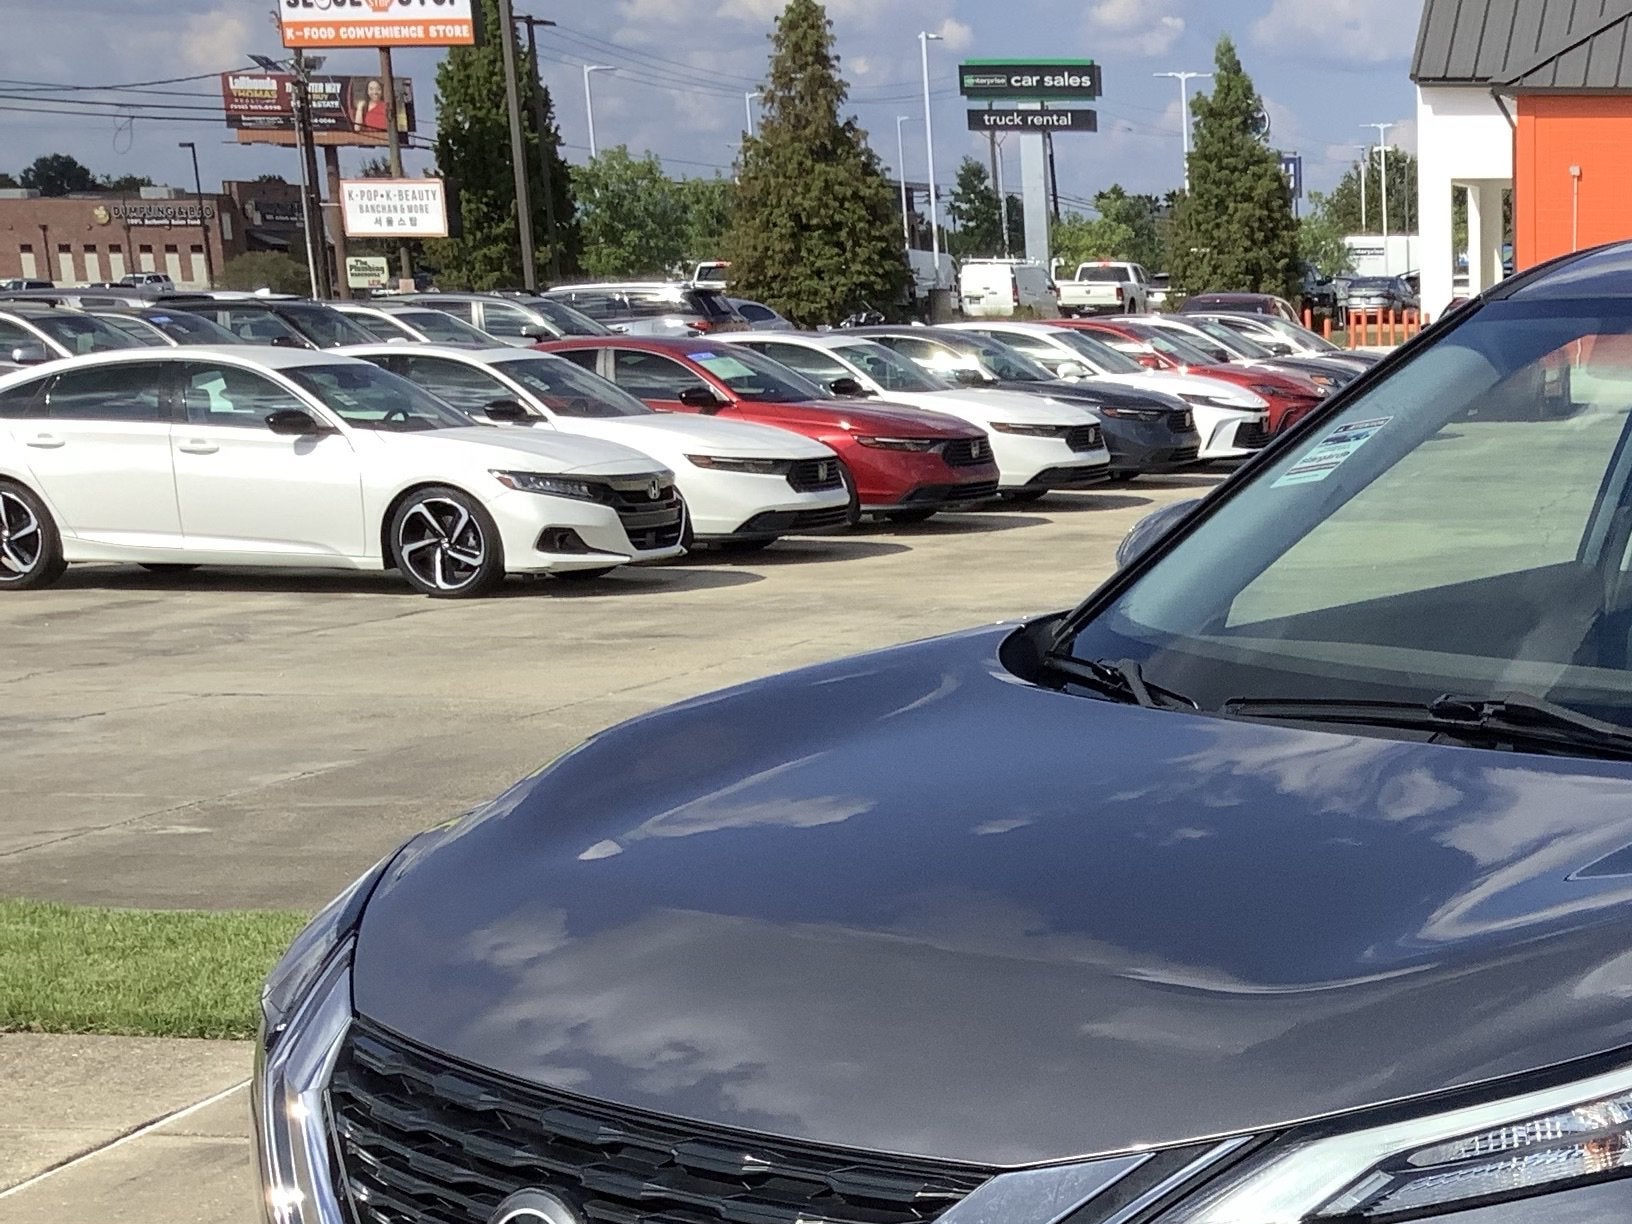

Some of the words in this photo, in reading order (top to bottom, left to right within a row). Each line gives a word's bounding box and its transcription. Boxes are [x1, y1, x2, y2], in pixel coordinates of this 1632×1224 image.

[286, 27, 335, 40] K-FOOD
[340, 26, 424, 39] CONVENIENCE
[429, 25, 470, 38] STORE
[1011, 75, 1040, 87] car
[1043, 72, 1091, 87] sales
[232, 89, 277, 98] THOMAS
[983, 112, 1022, 125] truck
[1027, 112, 1072, 125] rental
[113, 206, 174, 217] DUMPLING
[359, 204, 398, 214] BANCHAN
[407, 204, 429, 214] MORE
